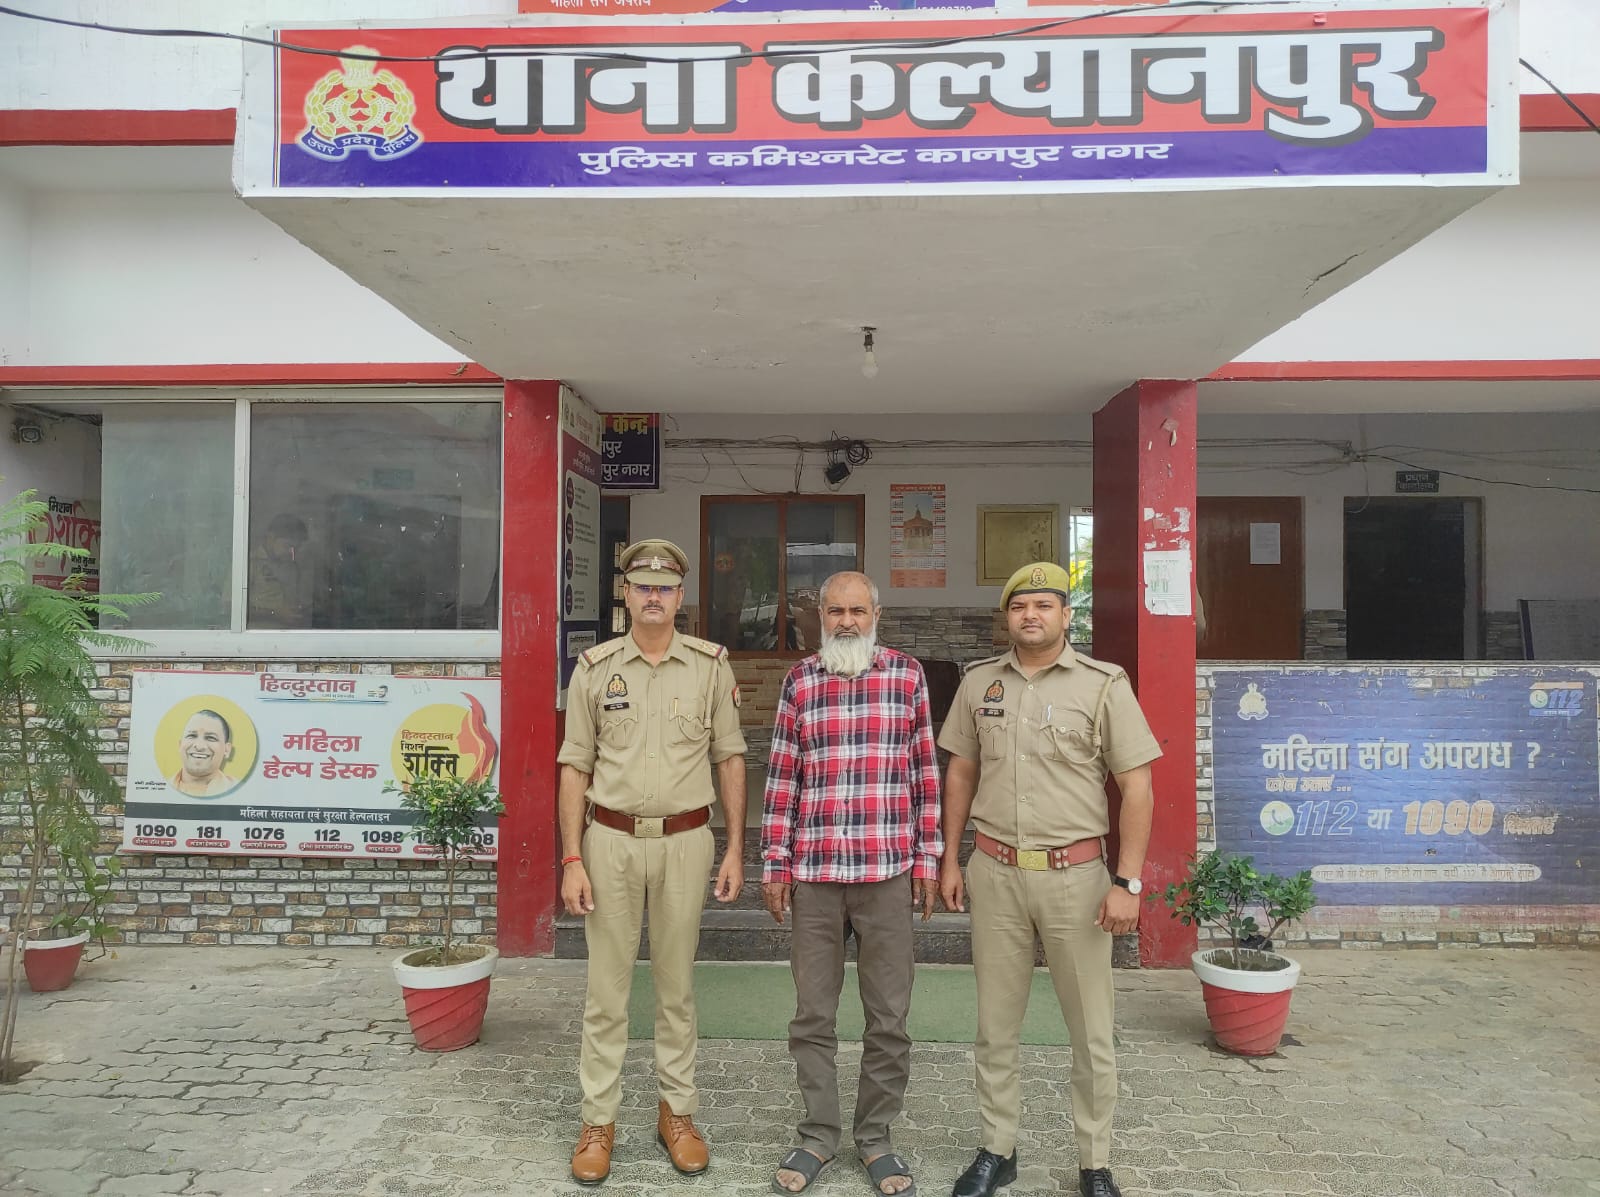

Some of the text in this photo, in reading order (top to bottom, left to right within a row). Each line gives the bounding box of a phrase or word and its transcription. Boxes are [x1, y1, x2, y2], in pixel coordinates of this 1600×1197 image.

[436, 29, 1438, 142] थाना कल्यानपुर
[307, 133, 416, 154] उत्तर प्रदेश पुलिस
[577, 142, 1173, 176] पुलिस कमिश्नरेट कानपुर नगर
[621, 463, 652, 477] नगर
[259, 673, 357, 698] हिन्दुस्तान
[1549, 689, 1584, 709] 112
[282, 727, 363, 753] महिला
[401, 740, 425, 752] मिशन
[402, 729, 454, 742] हिन्दुस्तान
[401, 745, 460, 779] शक्ति
[1261, 733, 1541, 772] महिला संग अपराध ?
[262, 755, 380, 781] हेल्प डेस्क
[240, 807, 391, 824] महिला सहायता एवं सुरक्षा हेल्पलाइन
[1295, 800, 1359, 836] 112
[1367, 808, 1393, 830] या
[1402, 800, 1495, 836] 1090
[135, 823, 177, 838] 1090
[196, 825, 223, 839] 181
[243, 826, 285, 841] 1076
[314, 828, 342, 842] 112
[361, 830, 403, 844] 1098
